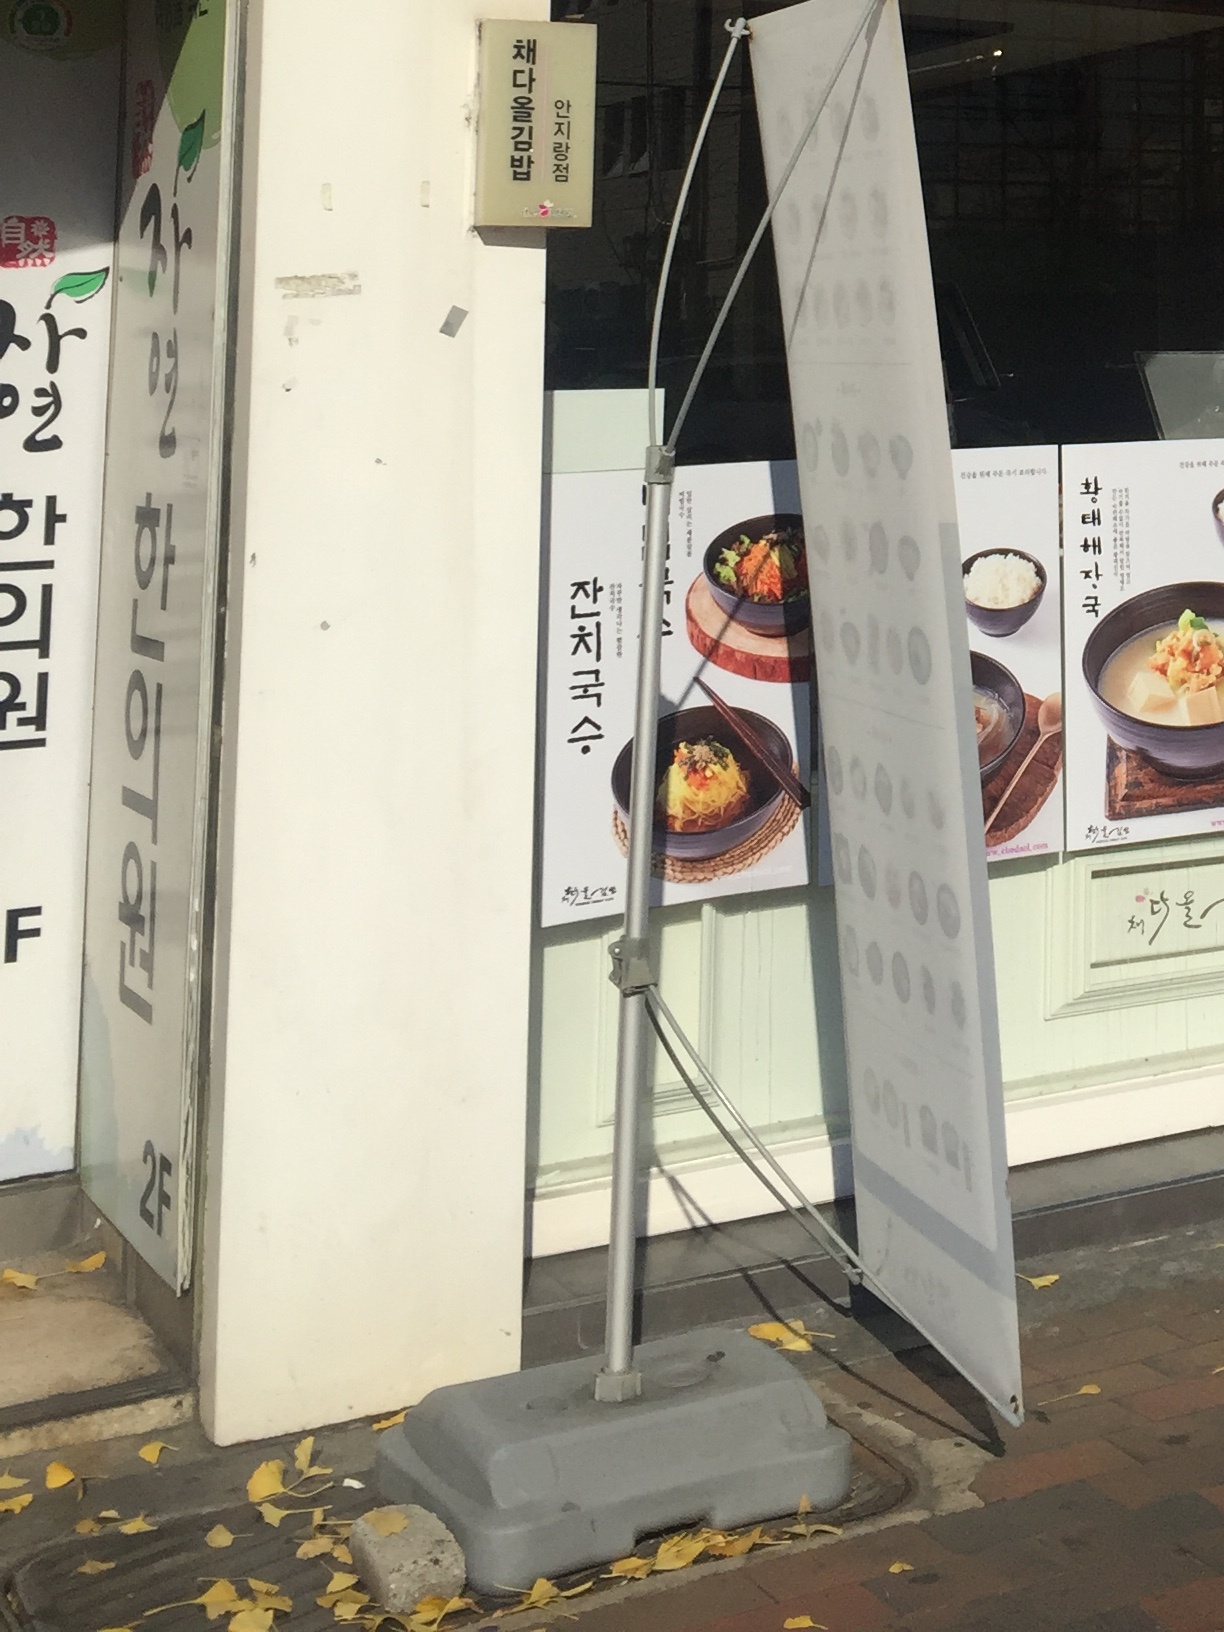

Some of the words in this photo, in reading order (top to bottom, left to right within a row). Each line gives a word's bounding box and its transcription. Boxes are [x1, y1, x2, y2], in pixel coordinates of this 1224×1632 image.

[510, 38, 537, 182] 채다올김밥
[552, 99, 572, 183] 안지랑점
[1079, 475, 1103, 618] 황태해장국
[568, 575, 605, 755] 잔치국수
[117, 490, 177, 1025] 한의원
[139, 1139, 173, 1239] 2F
